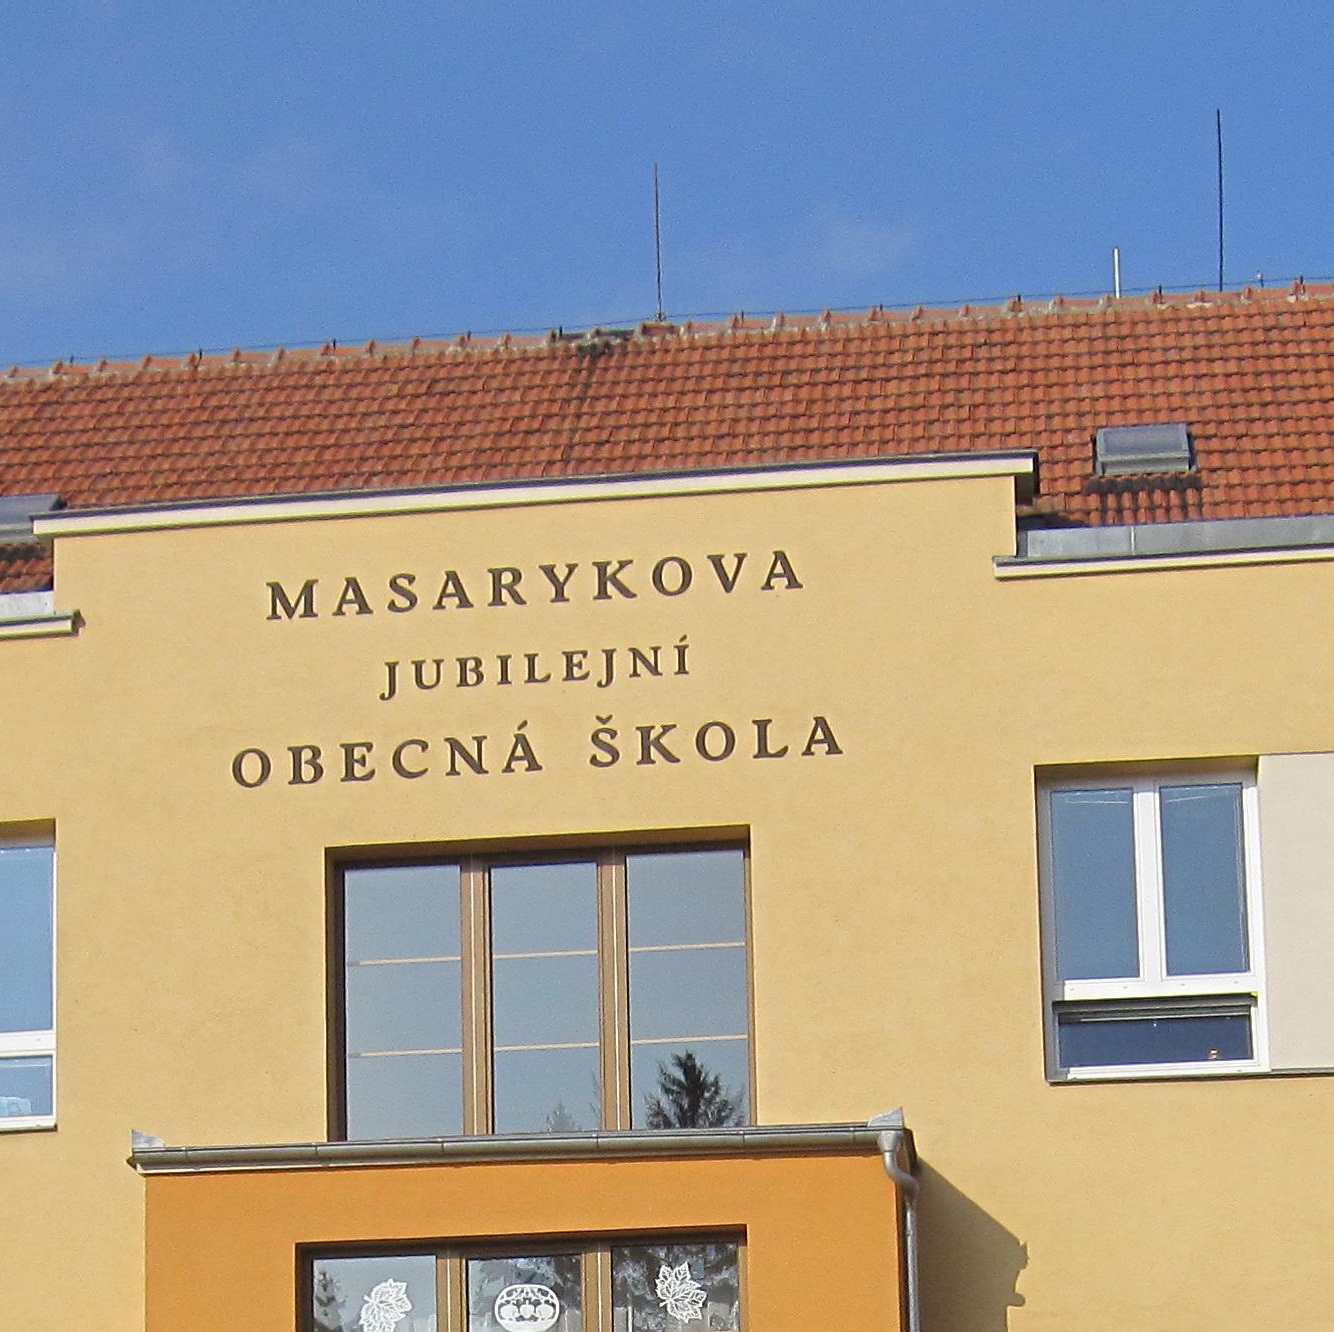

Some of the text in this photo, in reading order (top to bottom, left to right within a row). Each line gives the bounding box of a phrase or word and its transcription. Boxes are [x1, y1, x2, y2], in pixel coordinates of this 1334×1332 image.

[266, 550, 804, 621] MASARYKOVA
[379, 635, 690, 701] JUBILEJNÍ
[231, 715, 844, 789] OBECNÁ ŠKOLA
